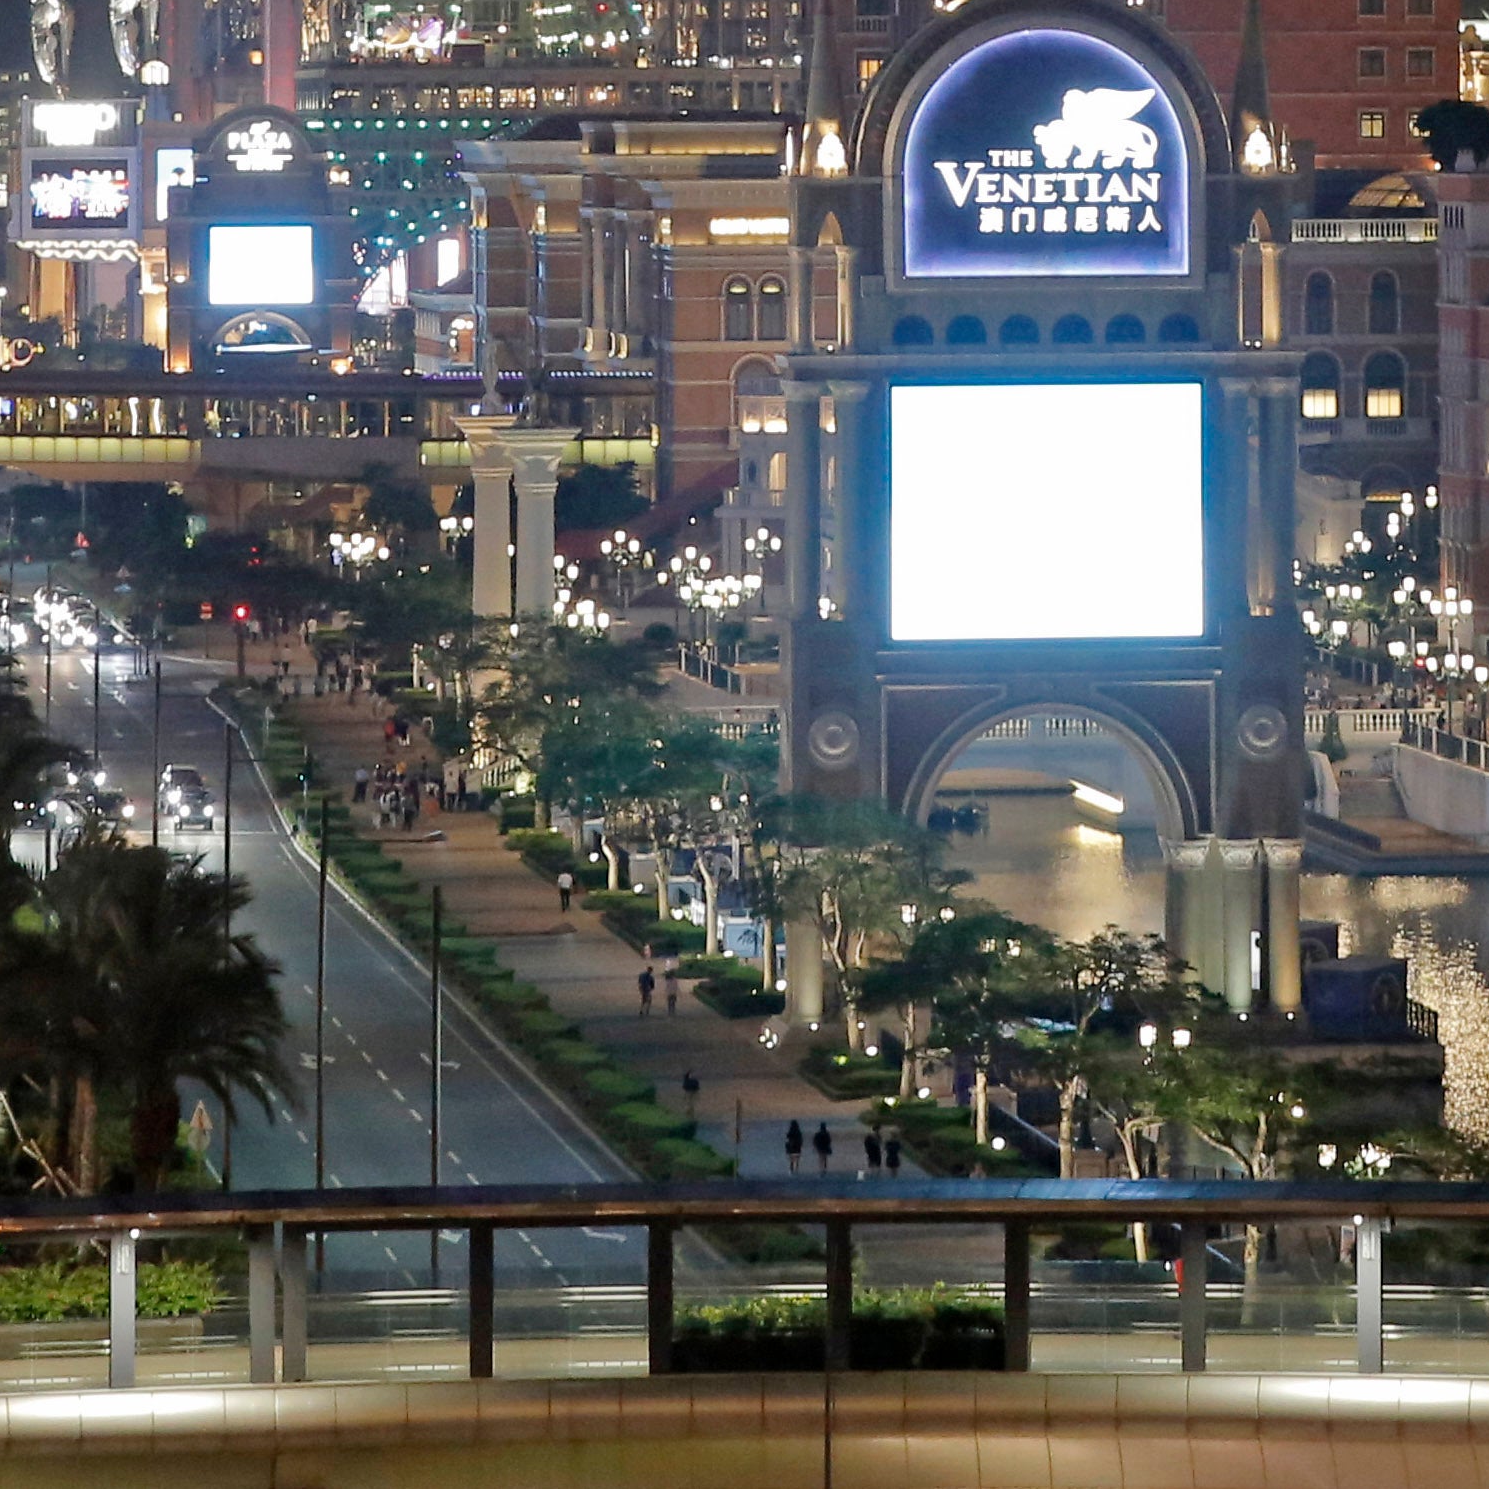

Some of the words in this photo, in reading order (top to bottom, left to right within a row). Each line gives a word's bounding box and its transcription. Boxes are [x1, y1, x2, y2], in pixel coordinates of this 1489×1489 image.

[227, 132, 293, 150] PLAZA
[987, 149, 1034, 168] THE
[933, 161, 1162, 208] VENETIAN
